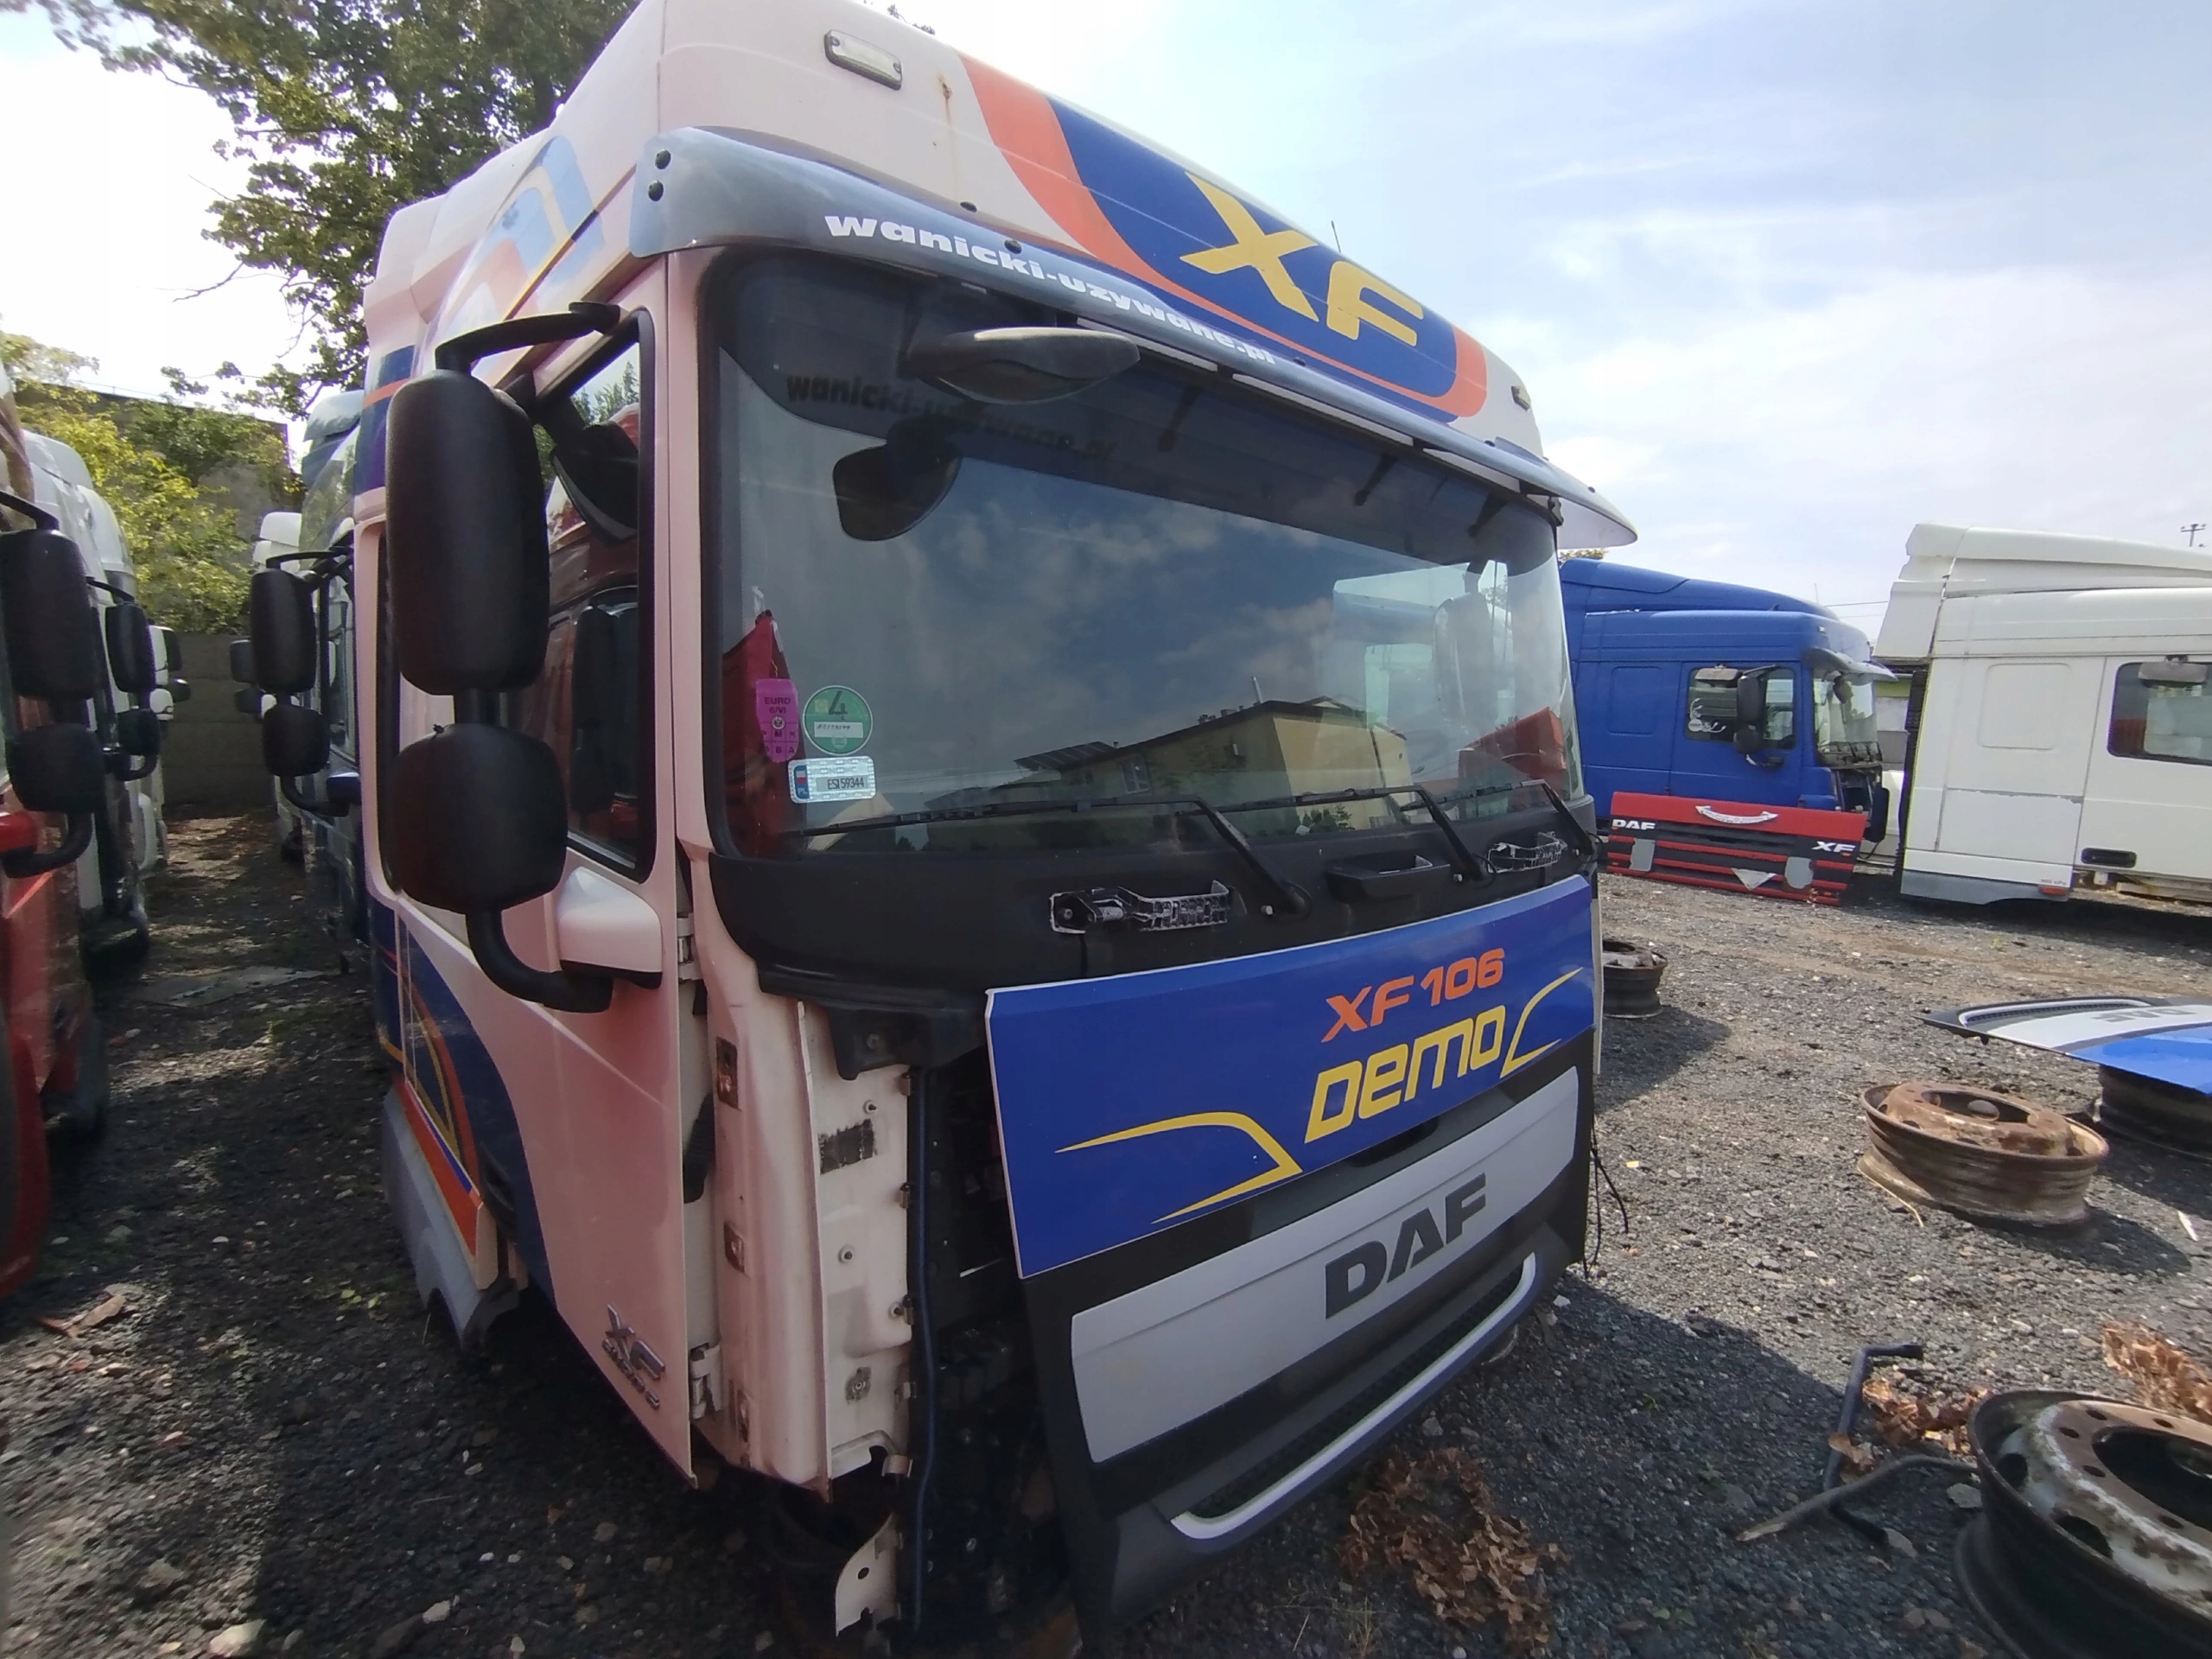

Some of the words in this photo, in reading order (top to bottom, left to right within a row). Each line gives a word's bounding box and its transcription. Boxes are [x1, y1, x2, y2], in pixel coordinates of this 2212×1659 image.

[1180, 171, 1424, 346] XF
[824, 215, 1276, 365] wanicki-uzywane.pl
[765, 696, 791, 705] EURO
[829, 690, 848, 715] 4
[1612, 819, 1656, 830] DAF
[1812, 841, 1856, 853] XF
[1322, 976, 1414, 1043] XF
[1421, 948, 1505, 1007] 106
[2091, 1007, 2197, 1023] DAF
[1325, 1173, 1486, 1319] DAF
